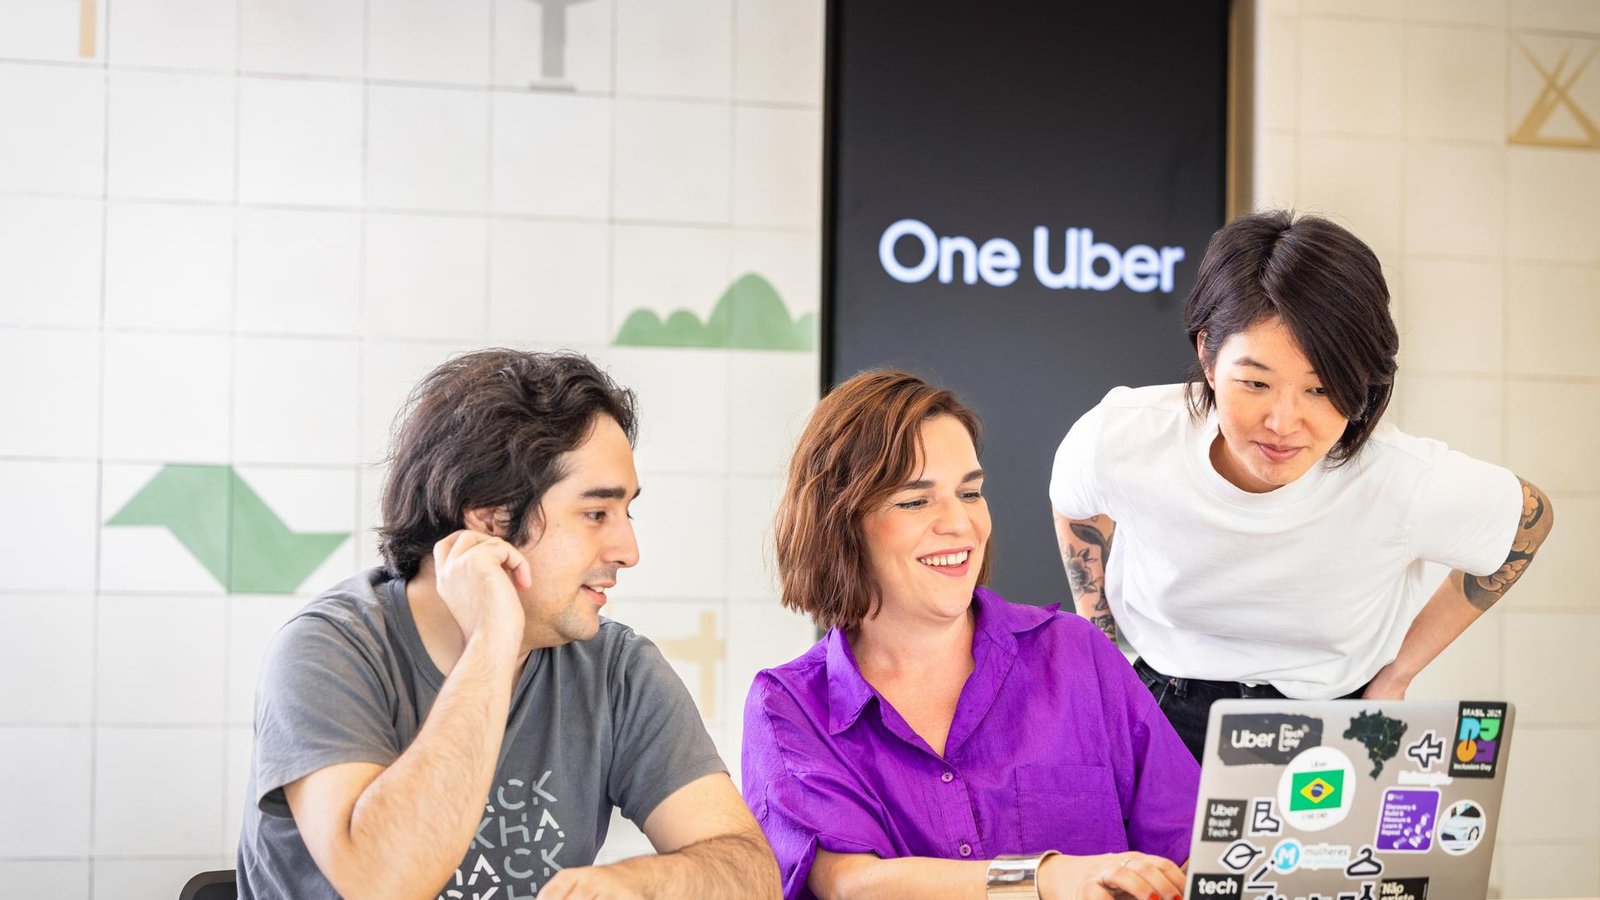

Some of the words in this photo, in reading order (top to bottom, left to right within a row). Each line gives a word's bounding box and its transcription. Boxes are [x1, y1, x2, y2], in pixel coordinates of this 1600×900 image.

[879, 219, 1021, 287] One
[1033, 226, 1184, 293] Uber
[1231, 730, 1276, 748] Uber
[1480, 764, 1492, 772] Day
[1211, 804, 1240, 816] Uber
[1208, 828, 1229, 837] Tech
[1304, 848, 1348, 857] mulheres
[1198, 877, 1238, 895] tech
[1382, 882, 1404, 895] Não
